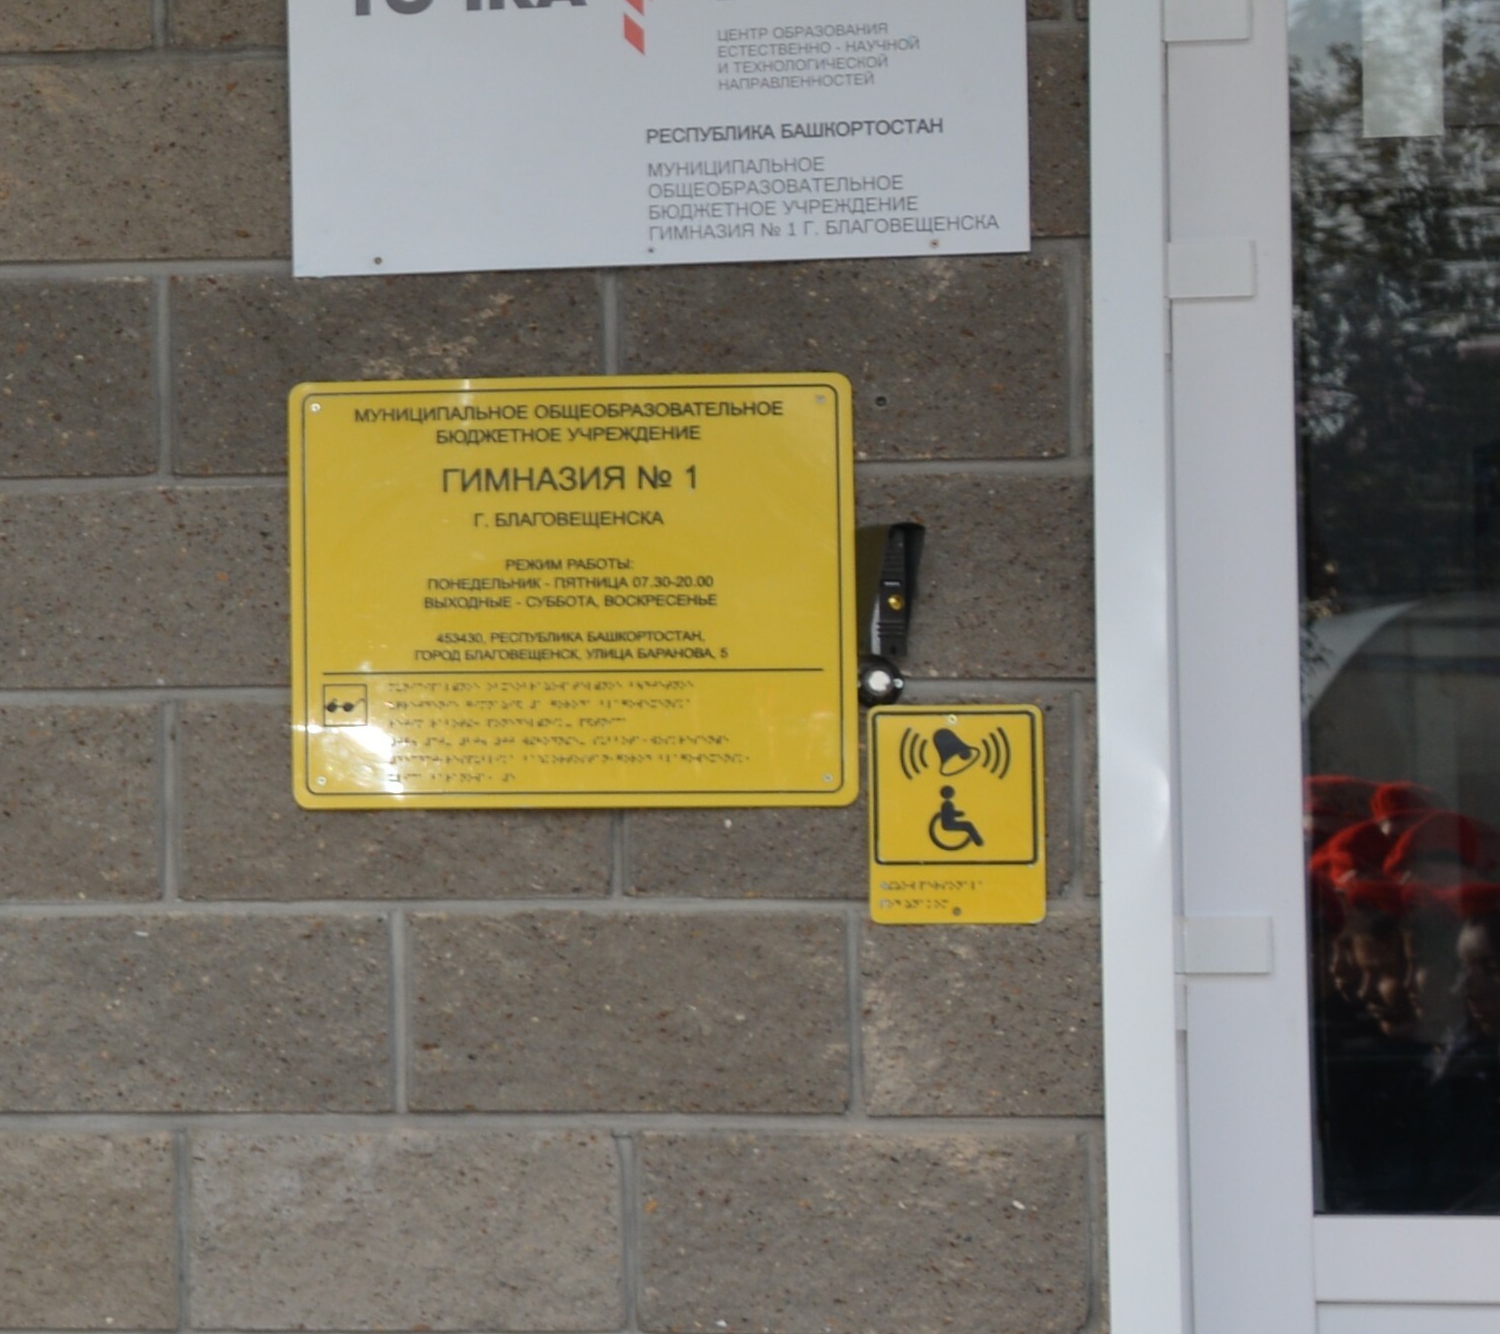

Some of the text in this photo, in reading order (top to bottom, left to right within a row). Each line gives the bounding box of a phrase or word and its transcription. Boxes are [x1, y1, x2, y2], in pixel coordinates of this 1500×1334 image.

[717, 22, 889, 42] ЦЕНТР ОБРАЗОВАНИЯ
[717, 41, 831, 57] ЕСТЕСТВЕННО
[845, 35, 920, 53] НАУЧНОЙ
[717, 53, 889, 74] И ТЕХНОЛОГИЧЕСКОЙ
[718, 71, 875, 90] НАПРАВЛЕННОСТЕЙ
[646, 118, 943, 144] РЕСПУБЛИКА БАШКОРТОСТАН
[648, 156, 825, 177] МУНИЦИПАЛЬНОЕ
[648, 175, 904, 199] ОБЩЕОБРАЗОВАТЕЛЬНОЕ
[649, 196, 918, 220] БЮДЖЕТНОЕ УЧРЕЖДЕНИЕ
[649, 215, 1000, 241] ГИМНАЗИЯ № 1 Г. БЛАГОВЕЩЕНСКА
[354, 400, 784, 424] МУНИЦИПАЛЬНОЕ ОБЩЕОБРАЗОВАТЕЛЬНОЕ
[436, 424, 701, 445] БЮДЖЕТНОЕ УЧРЕЖДЕНИЕ
[442, 464, 697, 493] ГИМНАЗИЯ № 1
[473, 510, 664, 529] Г. БЛАГОВЕЩЕНСКА
[505, 556, 634, 571] РЕЖИМ РАБОТЫ:
[427, 577, 541, 591] ПОНЕДЕЛЬНИК
[555, 576, 629, 591] ПЯТНИЦА
[632, 575, 714, 588] 07.30-20.00
[423, 596, 512, 610] ВЫХОДНЫЕ
[526, 595, 599, 609] СУББОТА,
[604, 593, 717, 607] ВОСКРЕСЕНЬЕ
[490, 631, 583, 644] РЕСПУБЛИКА
[587, 629, 706, 644] БАШКОРТОСТАН,
[415, 649, 461, 663] ГОРОД
[465, 648, 581, 662] БЛАГОВЕЩЕНСК,
[587, 647, 633, 662] УЛИЦА
[719, 646, 729, 659] 5
